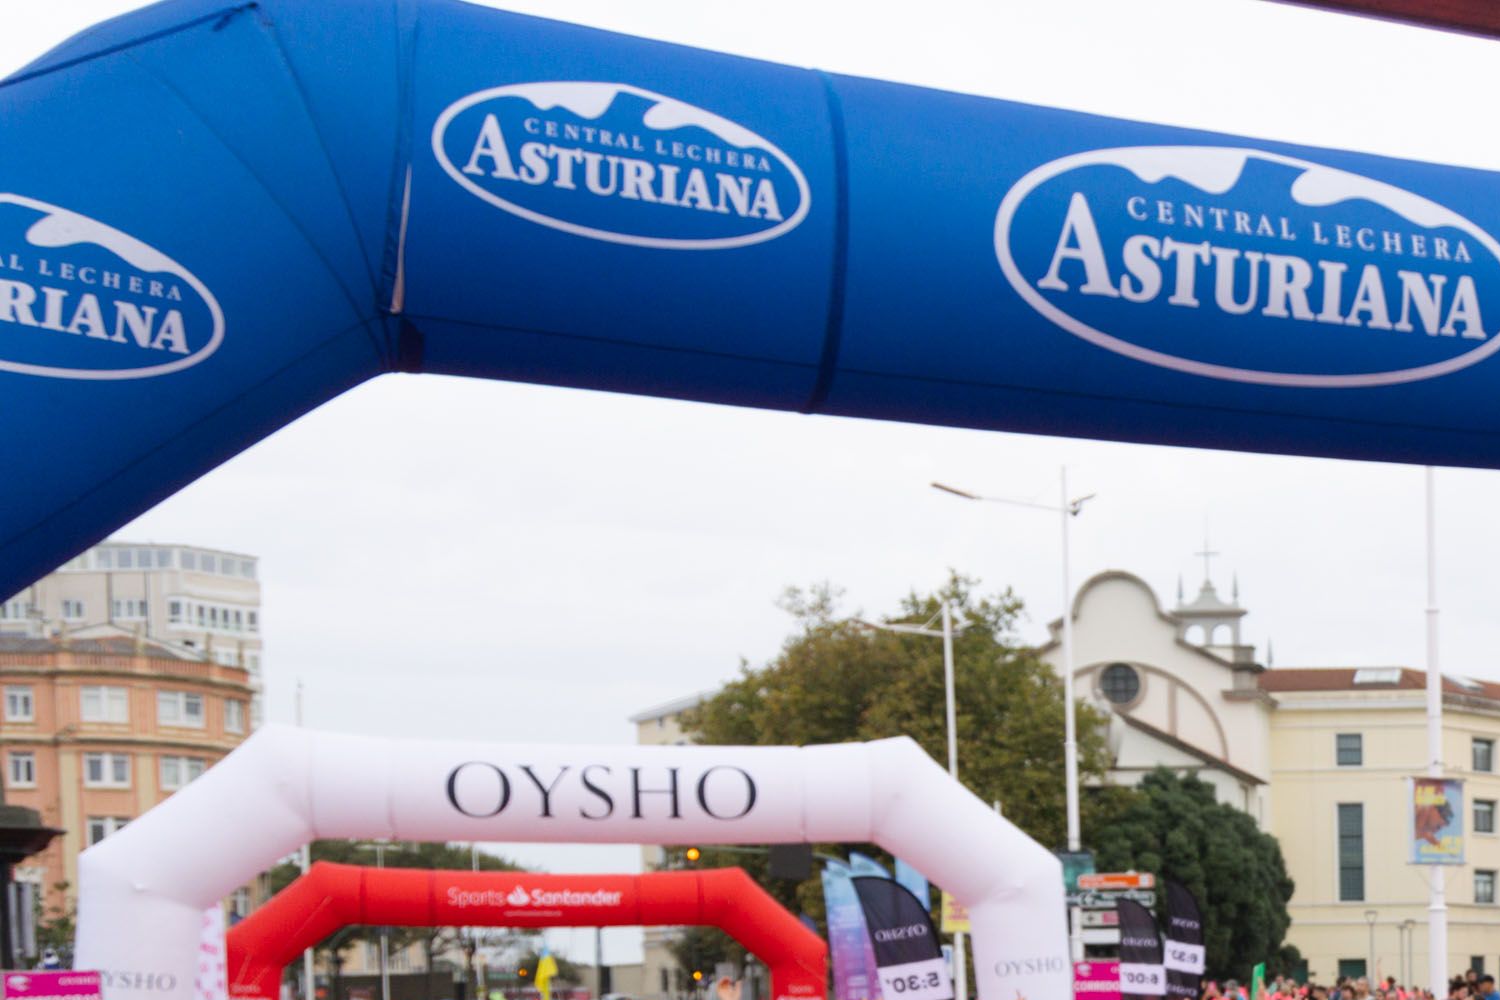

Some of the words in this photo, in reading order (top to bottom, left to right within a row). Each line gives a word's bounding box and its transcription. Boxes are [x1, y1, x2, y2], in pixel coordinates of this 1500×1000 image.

[462, 113, 784, 222] ASTURIANA
[524, 117, 644, 151] CENTRAL
[656, 139, 772, 172] LECHERA
[1126, 195, 1296, 240] CENTRAL
[1313, 221, 1473, 263] LECHERA
[39, 259, 182, 301] LECHERA
[1038, 192, 1487, 340] ASTURIANA
[445, 760, 758, 820] OYSHO
[447, 886, 505, 908] Sports
[531, 888, 622, 907] Santander
[102, 970, 177, 992] YSHO
[994, 956, 1064, 978] OYSHO
